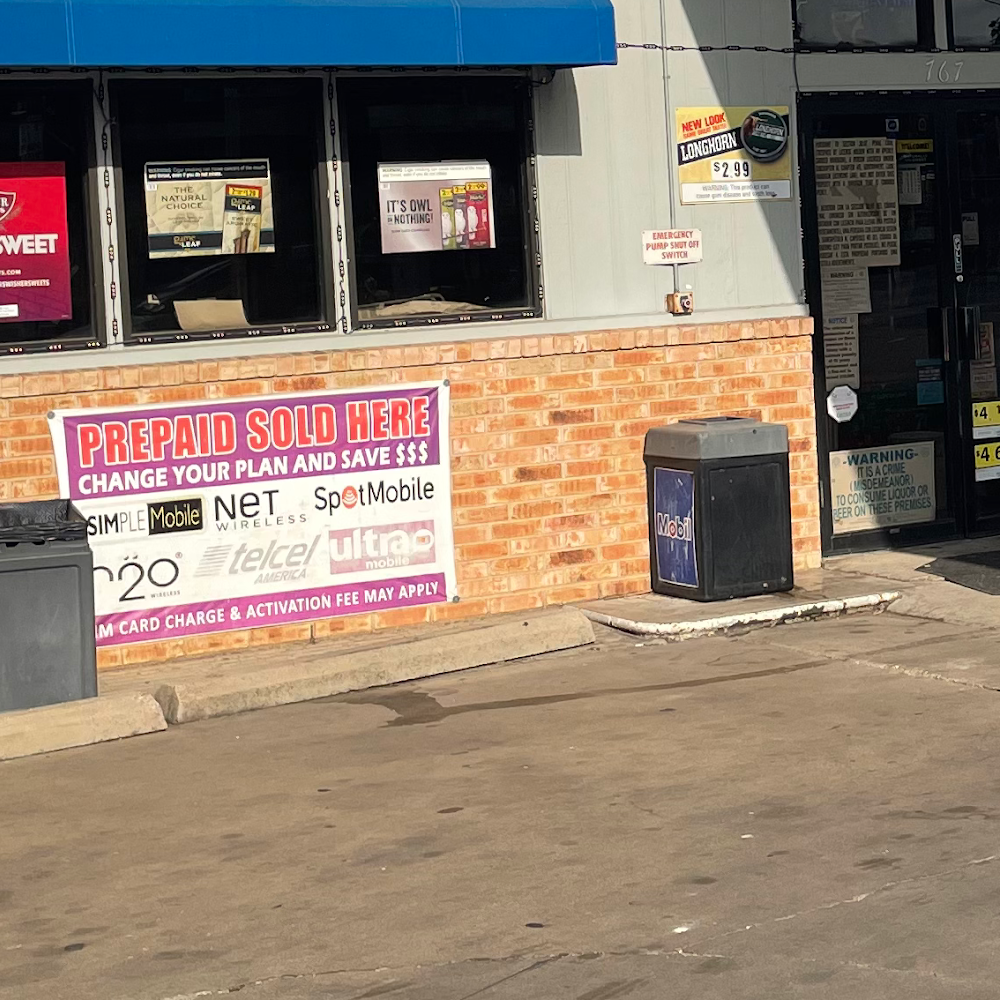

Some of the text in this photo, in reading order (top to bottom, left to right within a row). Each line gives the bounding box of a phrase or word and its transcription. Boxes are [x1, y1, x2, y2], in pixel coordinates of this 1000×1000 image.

[926, 59, 963, 82] 767
[682, 113, 726, 132] NEW LOOK
[680, 132, 738, 161] LONGHORN
[713, 162, 749, 178] $2.99
[161, 194, 207, 202] NATURAL
[166, 202, 203, 210] CHOICE
[387, 199, 407, 213] IT'S
[410, 198, 433, 212] OWL
[394, 212, 434, 224] NOTHING!
[652, 231, 693, 240] EMERGENCY
[646, 240, 699, 250] PUMP SHUT OFF
[661, 251, 688, 259] SWITCH
[77, 396, 430, 468] PREPAID SOLD HERE
[78, 440, 429, 495] CHANGE YOUR PLAN AND SAVE $$$
[857, 462, 905, 478] IT IS A CRIME
[836, 485, 929, 506] TO CONSUME LIQUOR OR
[854, 504, 866, 517] ON
[868, 502, 894, 515] THESE
[895, 498, 932, 511] PREMISES
[87, 502, 200, 535] SIMPLE Mobile
[216, 513, 307, 532] WIRELESS
[657, 512, 692, 541] Mobil
[228, 534, 321, 575] telcel
[365, 555, 411, 571] mobile
[254, 568, 307, 584] AMERICA
[150, 590, 181, 599] WIRELESS
[119, 617, 160, 635] CARD
[165, 608, 225, 629] CHARGE
[230, 606, 241, 620] &
[246, 594, 331, 619] ACTIVATION
[336, 591, 360, 607] FEE
[364, 586, 394, 604] MAY
[399, 581, 439, 600] APPLY
